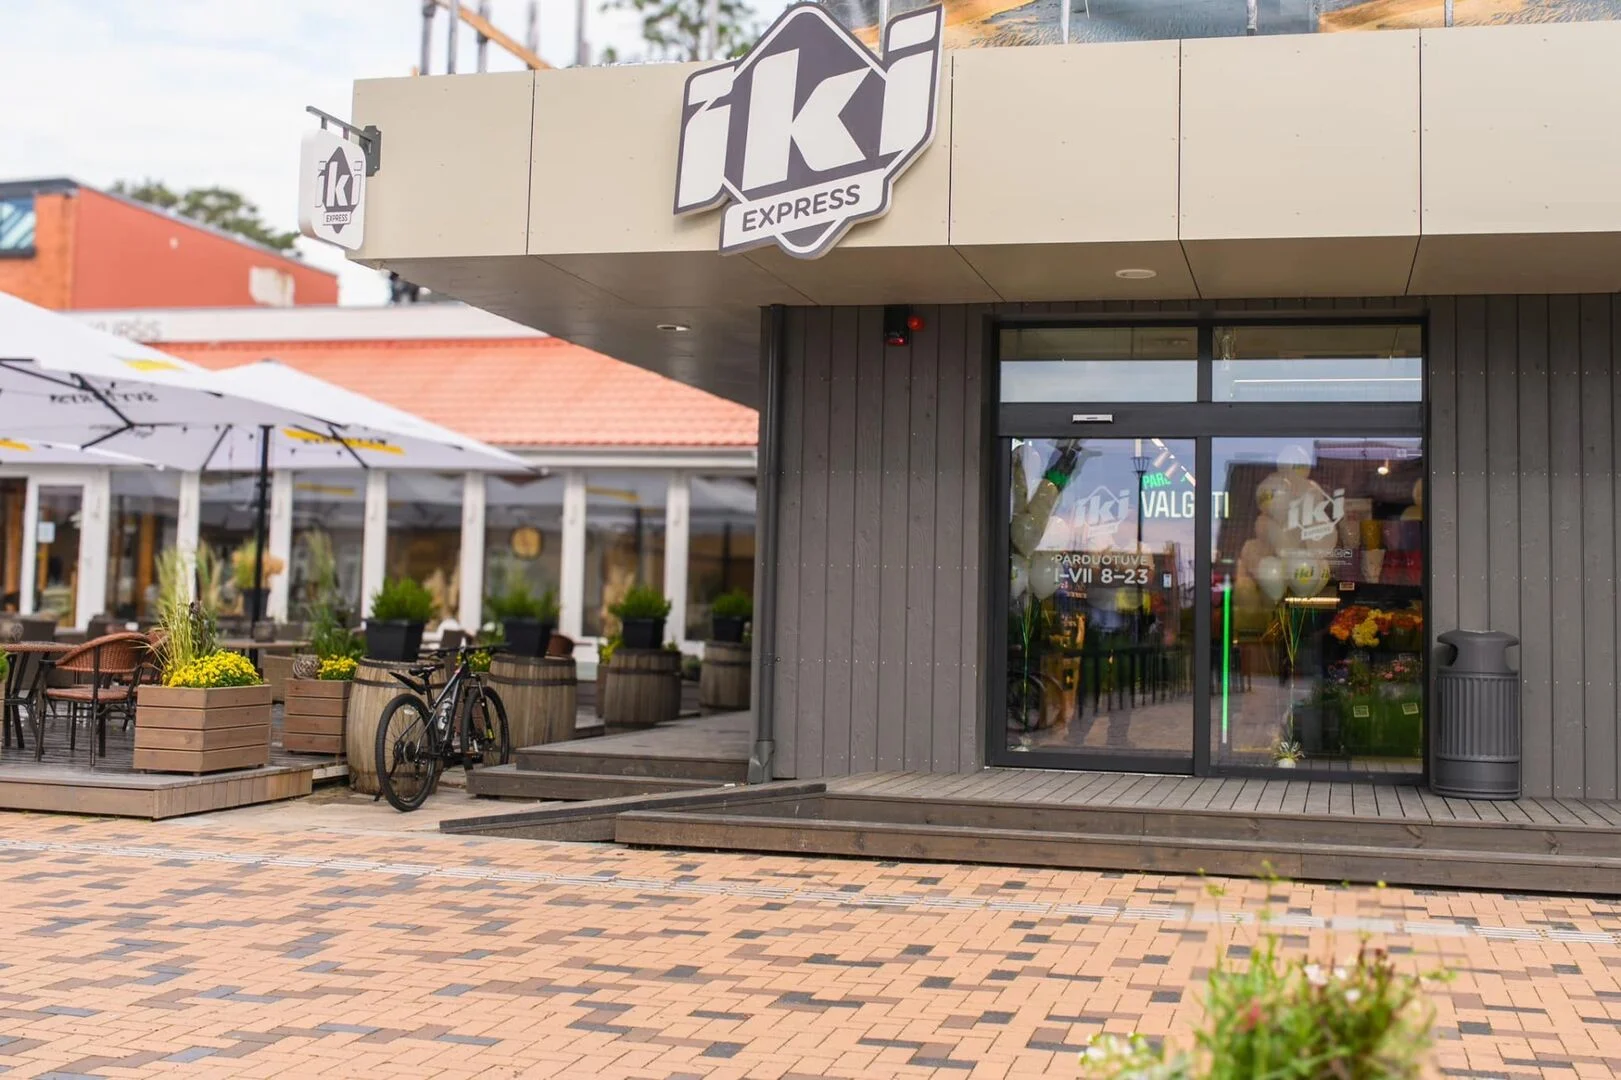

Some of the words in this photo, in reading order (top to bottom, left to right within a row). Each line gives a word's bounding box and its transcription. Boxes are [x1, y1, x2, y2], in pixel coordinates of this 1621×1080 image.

[677, 10, 938, 208] iki
[315, 160, 363, 208] iki
[326, 212, 349, 223] EXPRESS
[742, 184, 861, 233] EXPRESS
[1141, 490, 1229, 519] VALGTI
[1287, 488, 1345, 530] iki
